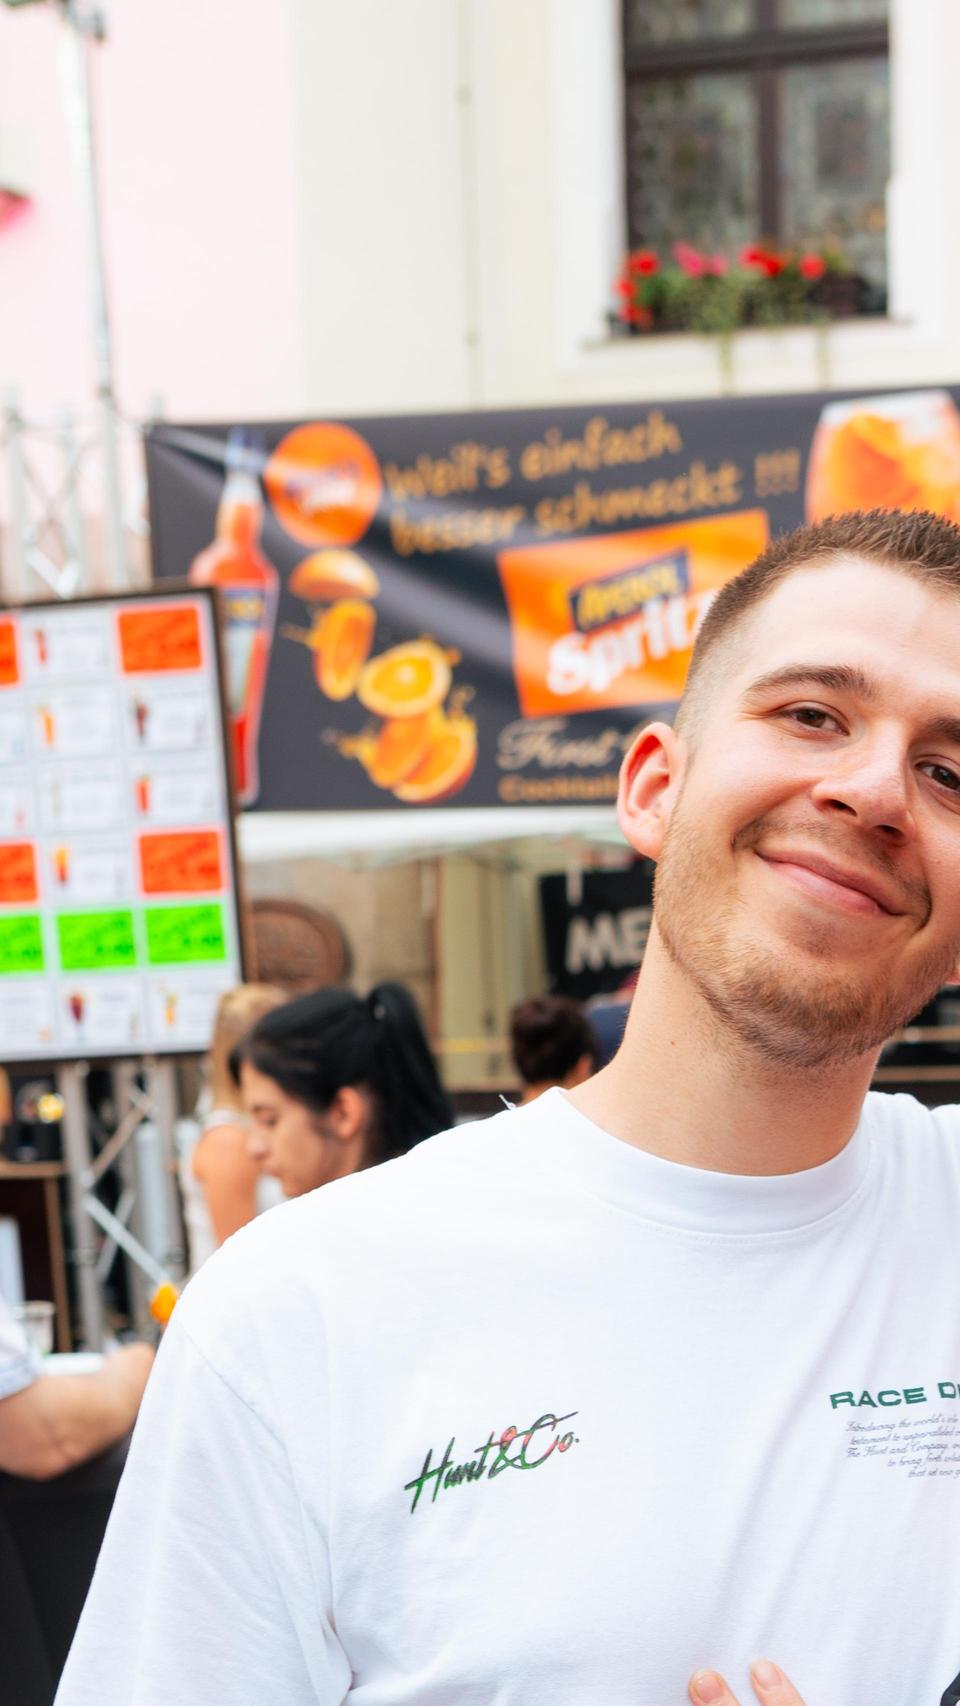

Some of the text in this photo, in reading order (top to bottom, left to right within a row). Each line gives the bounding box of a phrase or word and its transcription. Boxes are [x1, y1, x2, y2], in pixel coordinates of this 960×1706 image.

[384, 442, 511, 501] Weil's
[520, 410, 682, 481] einfach
[390, 504, 526, 556] besser
[534, 459, 744, 535] schmeckt
[829, 1387, 927, 1409] RACE
